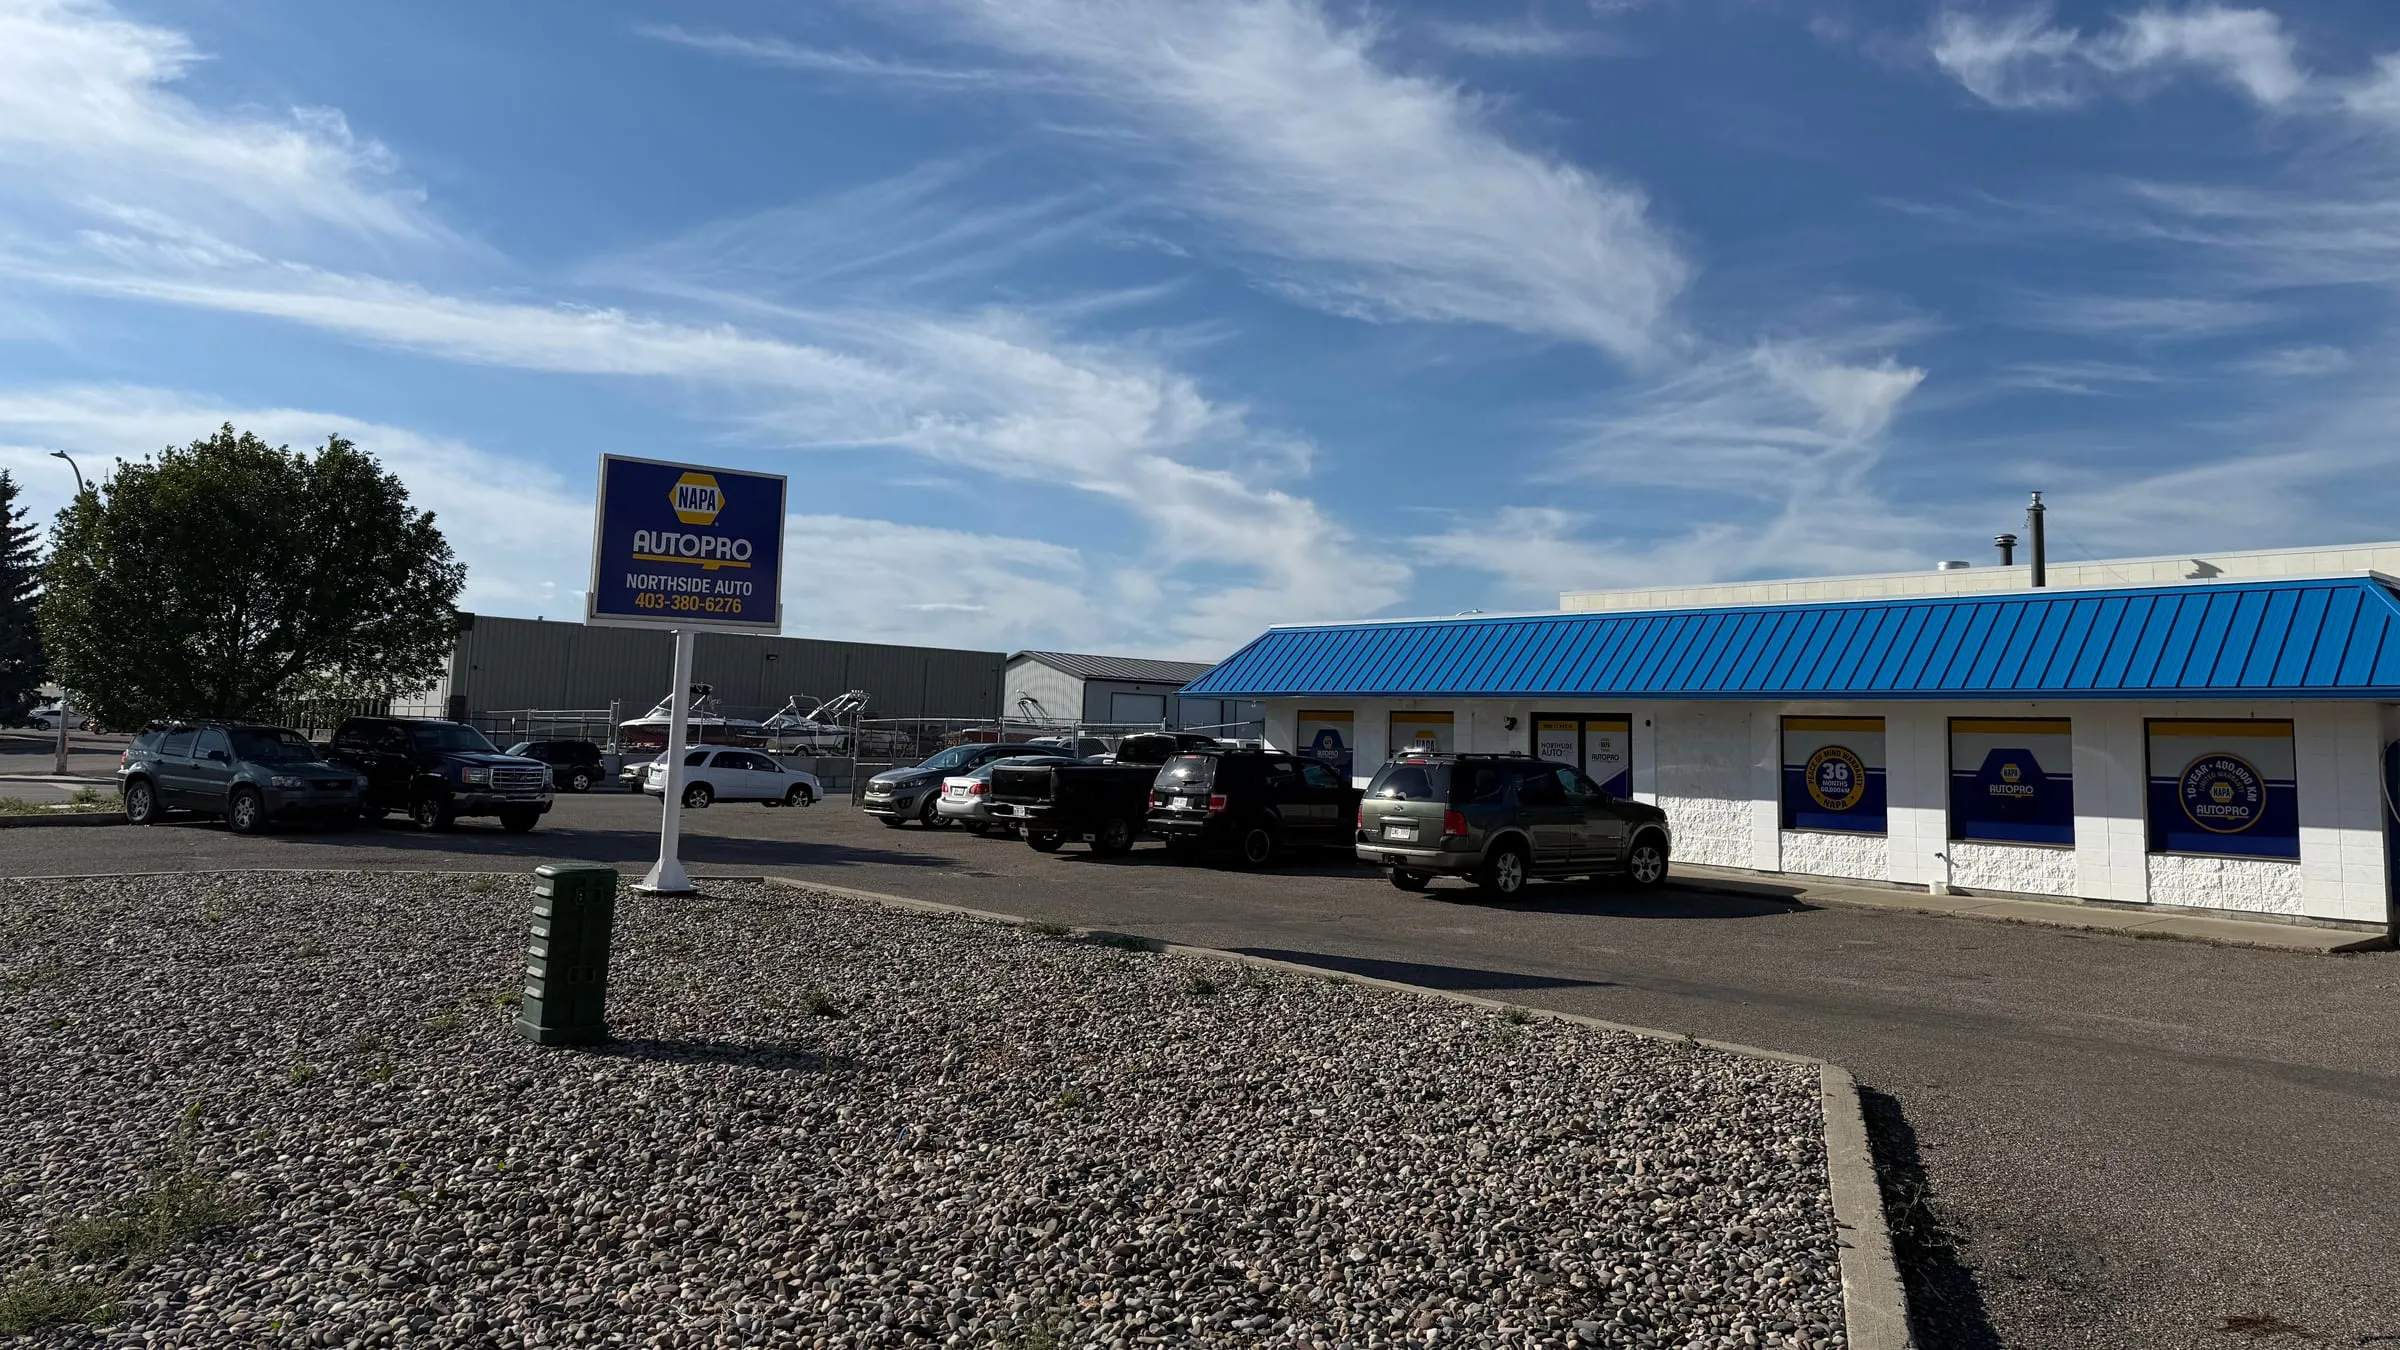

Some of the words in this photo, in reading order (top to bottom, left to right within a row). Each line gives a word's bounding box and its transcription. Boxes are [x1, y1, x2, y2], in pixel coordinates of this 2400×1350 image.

[678, 486, 716, 511] NAPA
[633, 529, 752, 561] AUTOPRO
[626, 573, 711, 594] NORTHSIDE
[714, 580, 753, 596] AUTO
[635, 592, 742, 614] 403-380-6276
[1541, 742, 1572, 750] NORTHSIDE
[1541, 748, 1563, 757] AUTO
[1591, 753, 1620, 761] AUTOPRO
[1823, 749, 1842, 757] MIND
[1822, 762, 1848, 780] 36
[2003, 768, 2019, 777] NAPA
[2187, 764, 2209, 799] 10-YEAR
[2215, 760, 2253, 785] 400,000
[2246, 786, 2257, 802] KM
[1989, 784, 2034, 794] AUTOPRO
[2213, 787, 2232, 798] NAPA
[1823, 798, 1848, 809] NAPA
[2196, 804, 2249, 816] AUTOPRO
